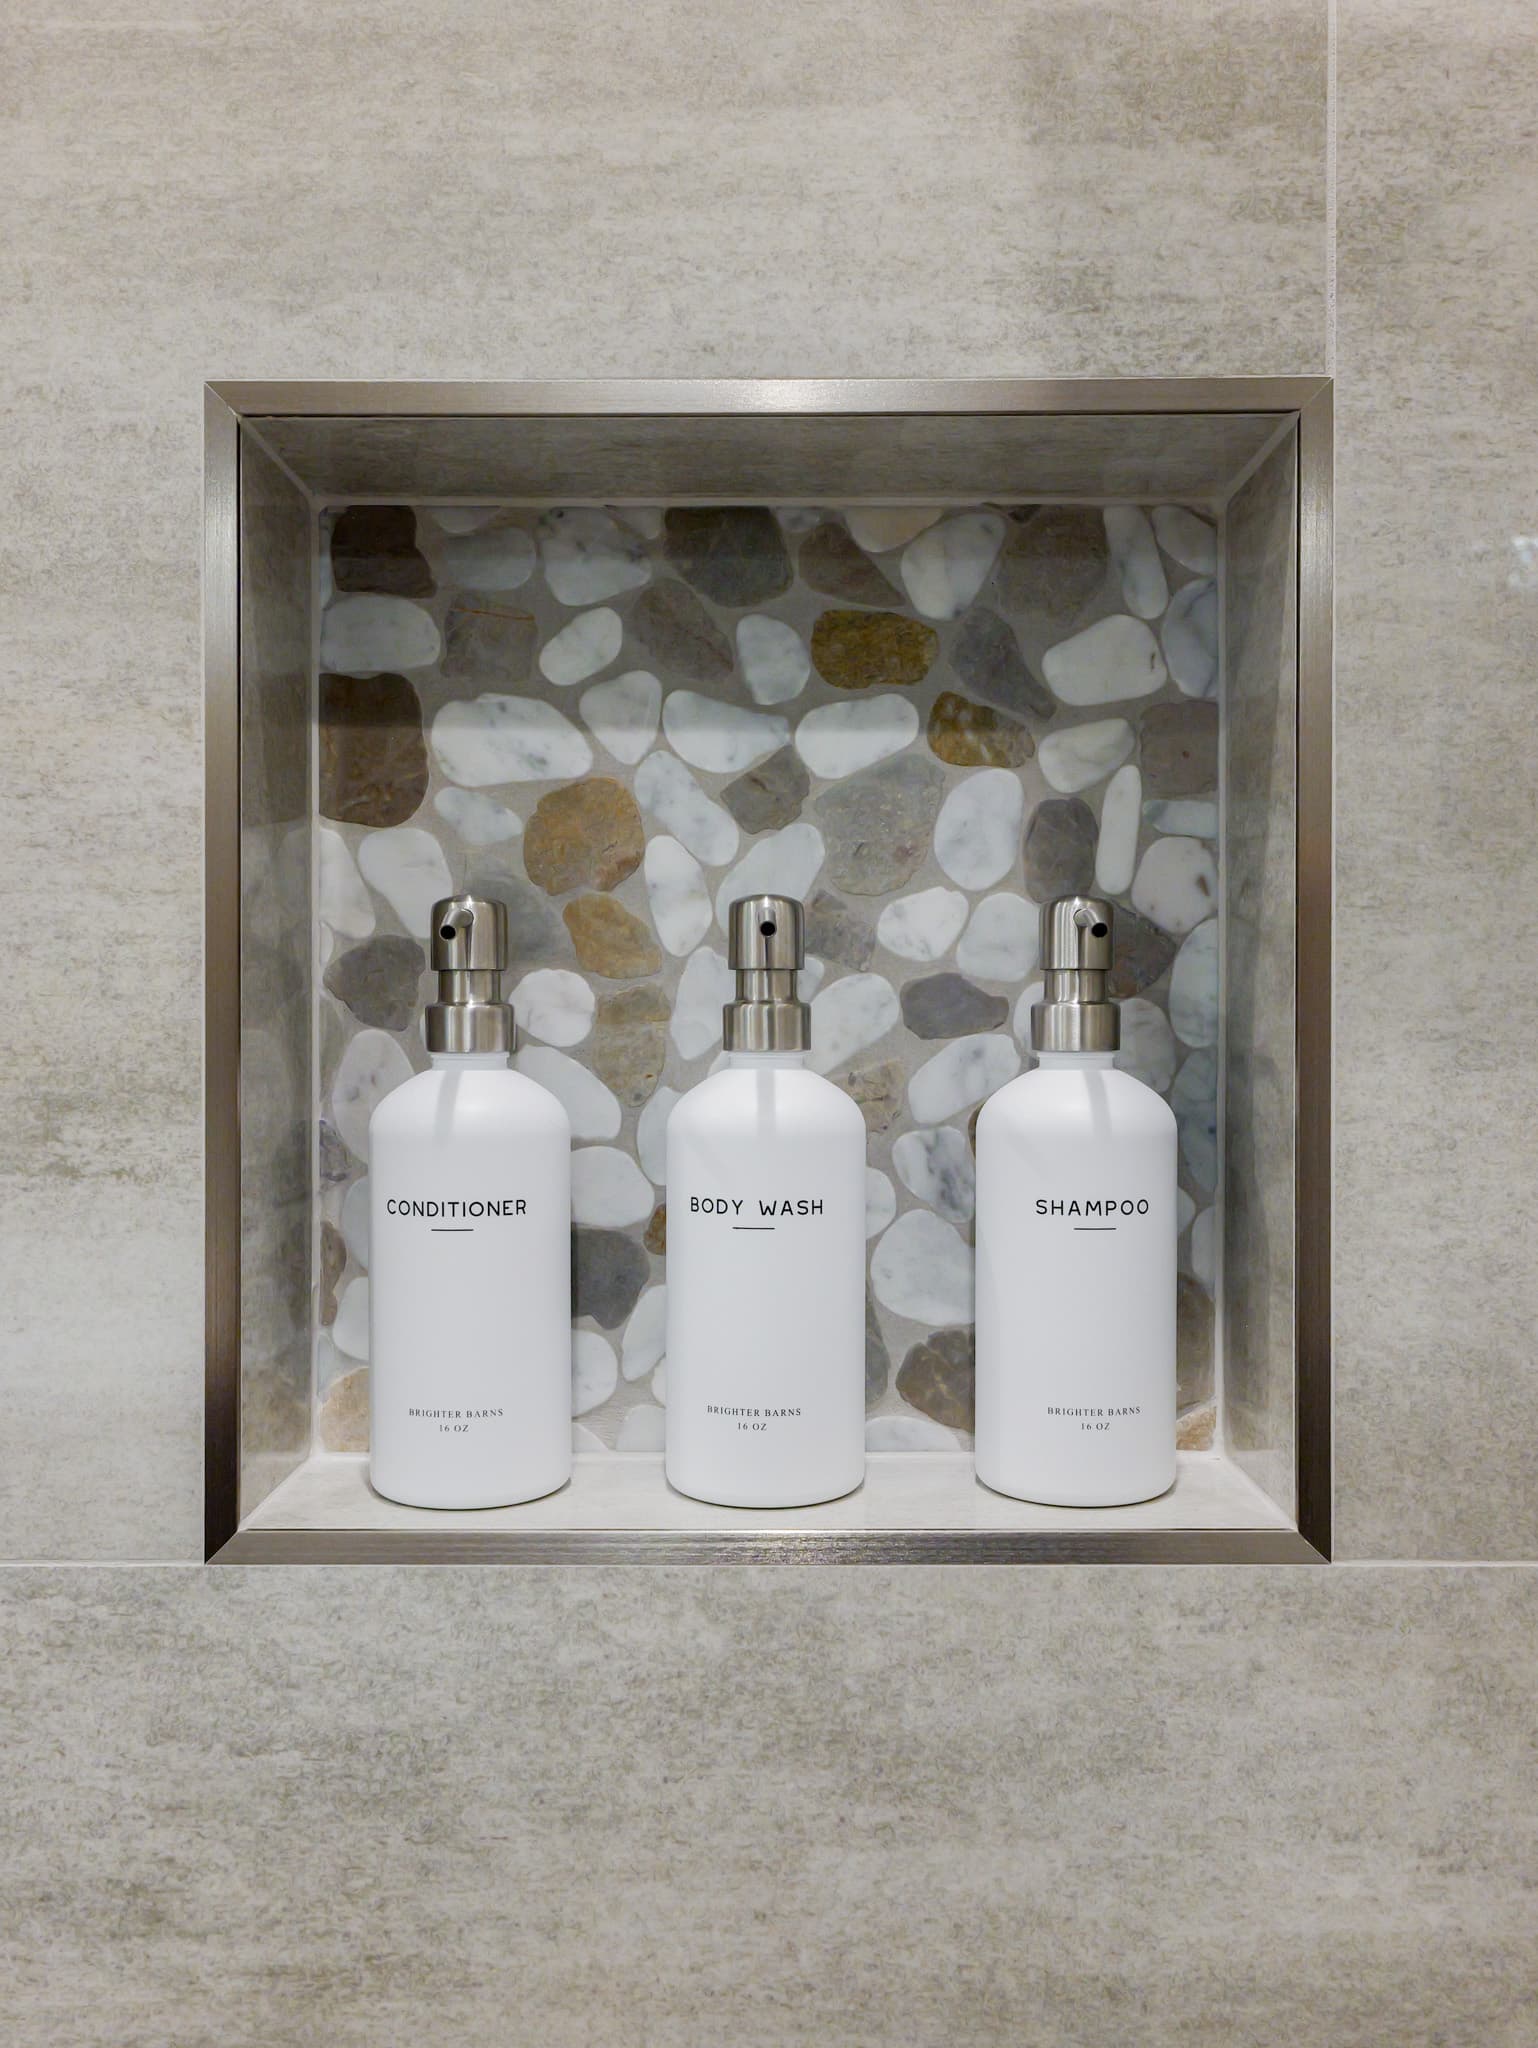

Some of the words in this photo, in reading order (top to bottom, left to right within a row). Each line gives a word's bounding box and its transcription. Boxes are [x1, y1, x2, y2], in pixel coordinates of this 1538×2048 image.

[386, 1198, 528, 1218] CONDITIONER
[690, 1196, 744, 1216] BODY
[758, 1198, 825, 1216] WASH
[1035, 1198, 1150, 1217] SHAMPOO
[408, 1407, 463, 1419] BRIGHTER
[465, 1407, 504, 1418] BARNS
[706, 1404, 761, 1417] BRIGHTER
[763, 1406, 802, 1417] BARNS
[1047, 1406, 1104, 1417] BRIGHTER
[1107, 1406, 1142, 1417] BARNS
[438, 1423, 450, 1433] 16
[453, 1423, 470, 1433] OZ
[736, 1422, 749, 1432] 16
[752, 1422, 768, 1432] OZ
[1080, 1422, 1092, 1432] 16
[1095, 1422, 1111, 1431] OZ
